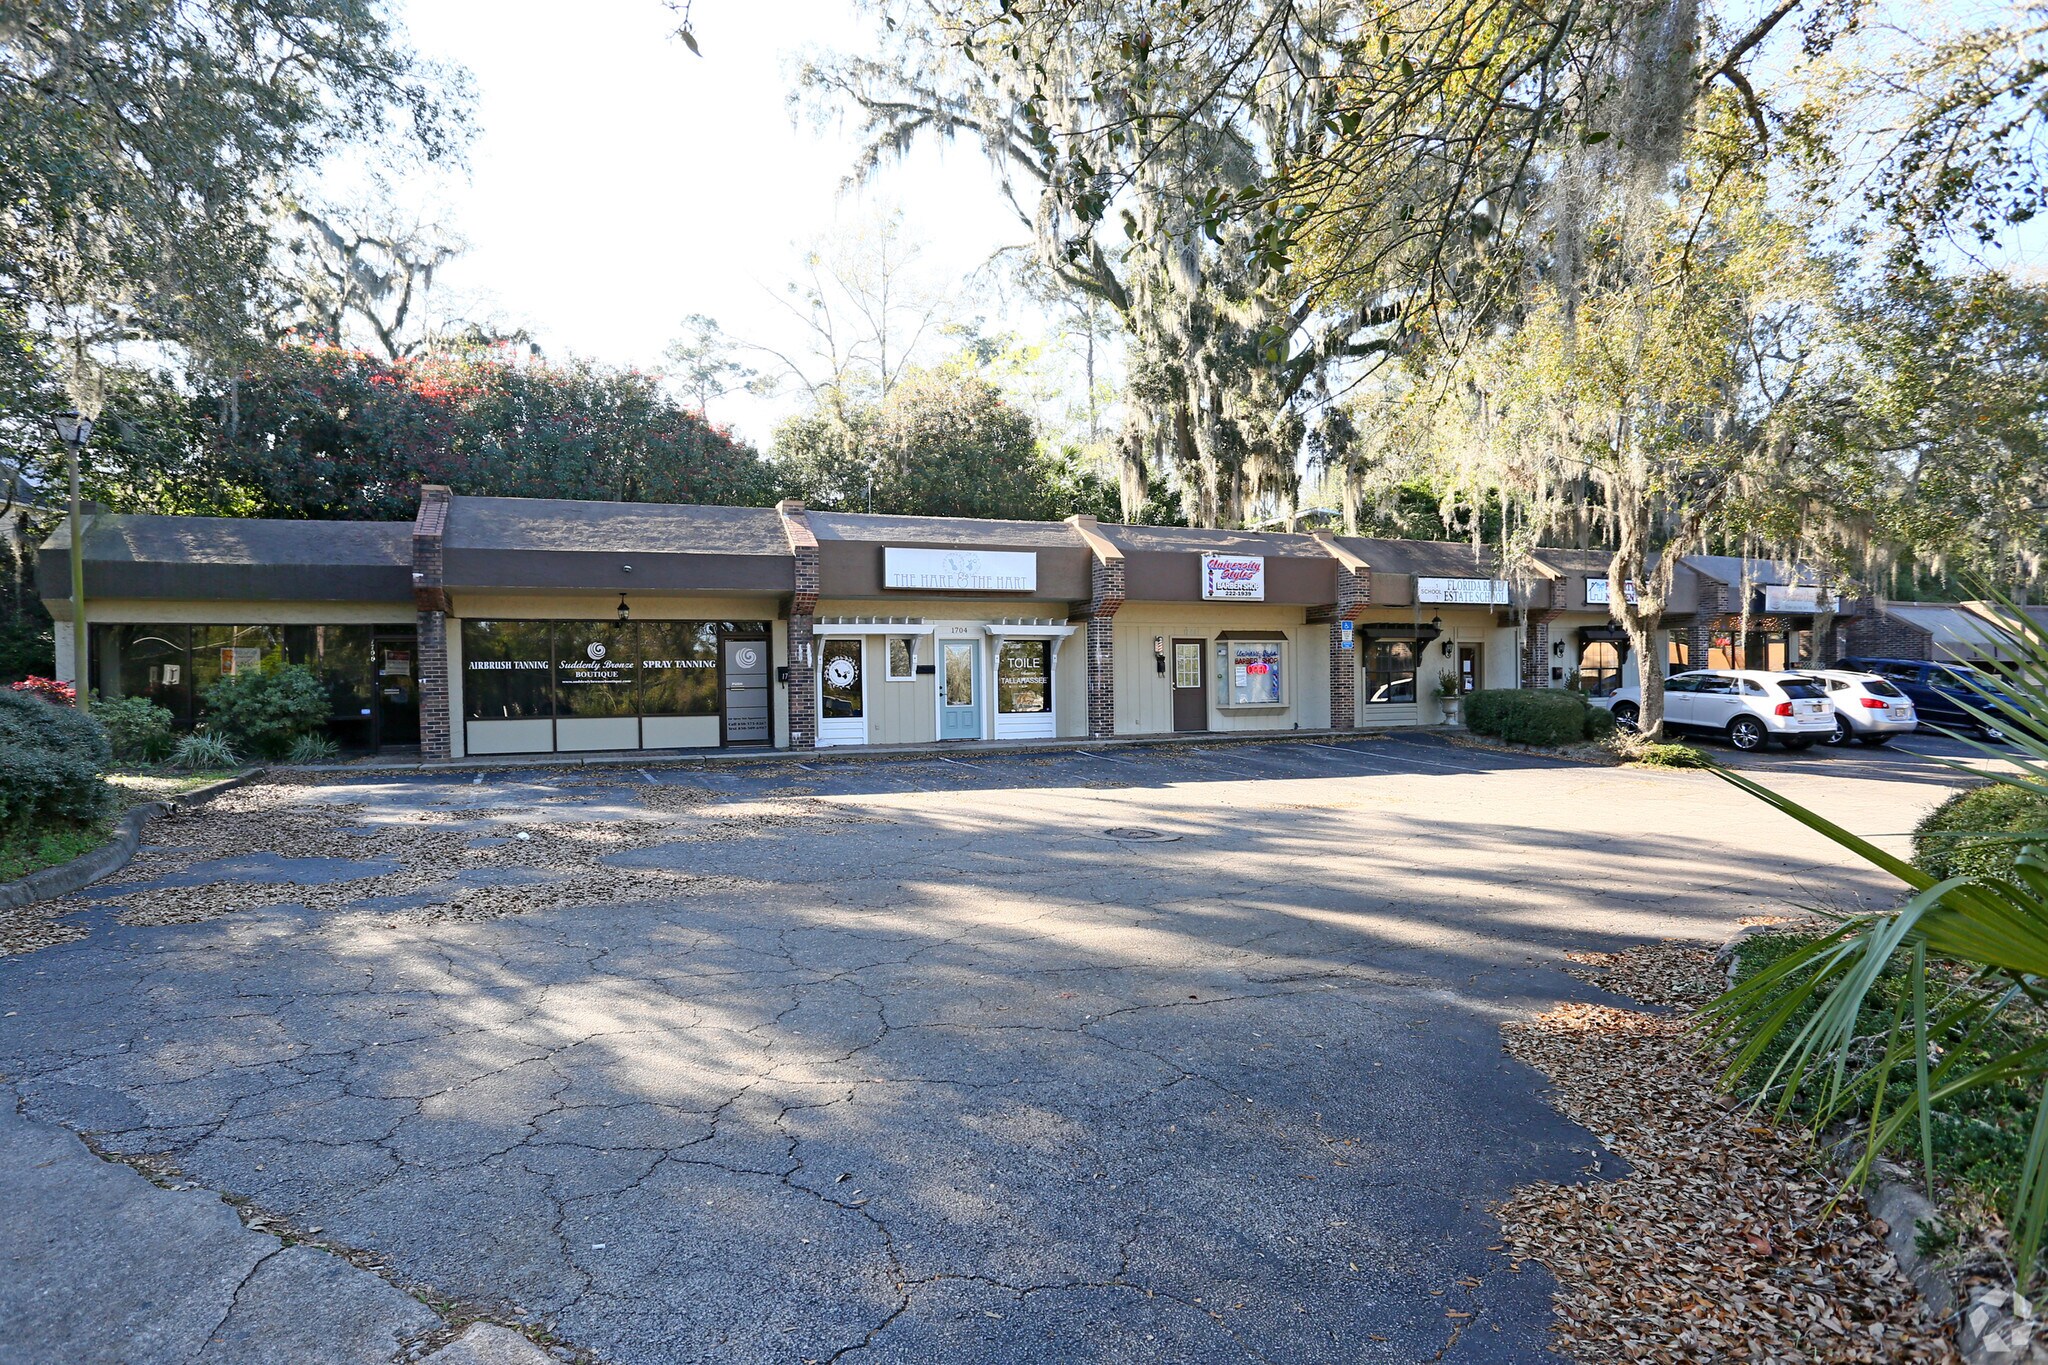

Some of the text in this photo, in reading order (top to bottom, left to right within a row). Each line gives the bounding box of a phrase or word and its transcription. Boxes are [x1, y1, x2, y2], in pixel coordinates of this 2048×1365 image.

[1207, 559, 1260, 572] University
[894, 571, 1027, 589] THE HARE & THE HART
[1221, 569, 1254, 582] Styles
[1447, 580, 1481, 592] FLORIDA
[1444, 590, 1506, 603] ESTATE SCHOOL
[468, 661, 549, 670] AIRBRUSH TANNING
[559, 660, 634, 671] Suddenly Bronze
[674, 660, 716, 668] TANNING
[1007, 657, 1041, 669] TOILE
[1234, 657, 1258, 665] BARBER
[575, 671, 619, 679] BOUTIQUE
[1246, 664, 1268, 675] OPEN
